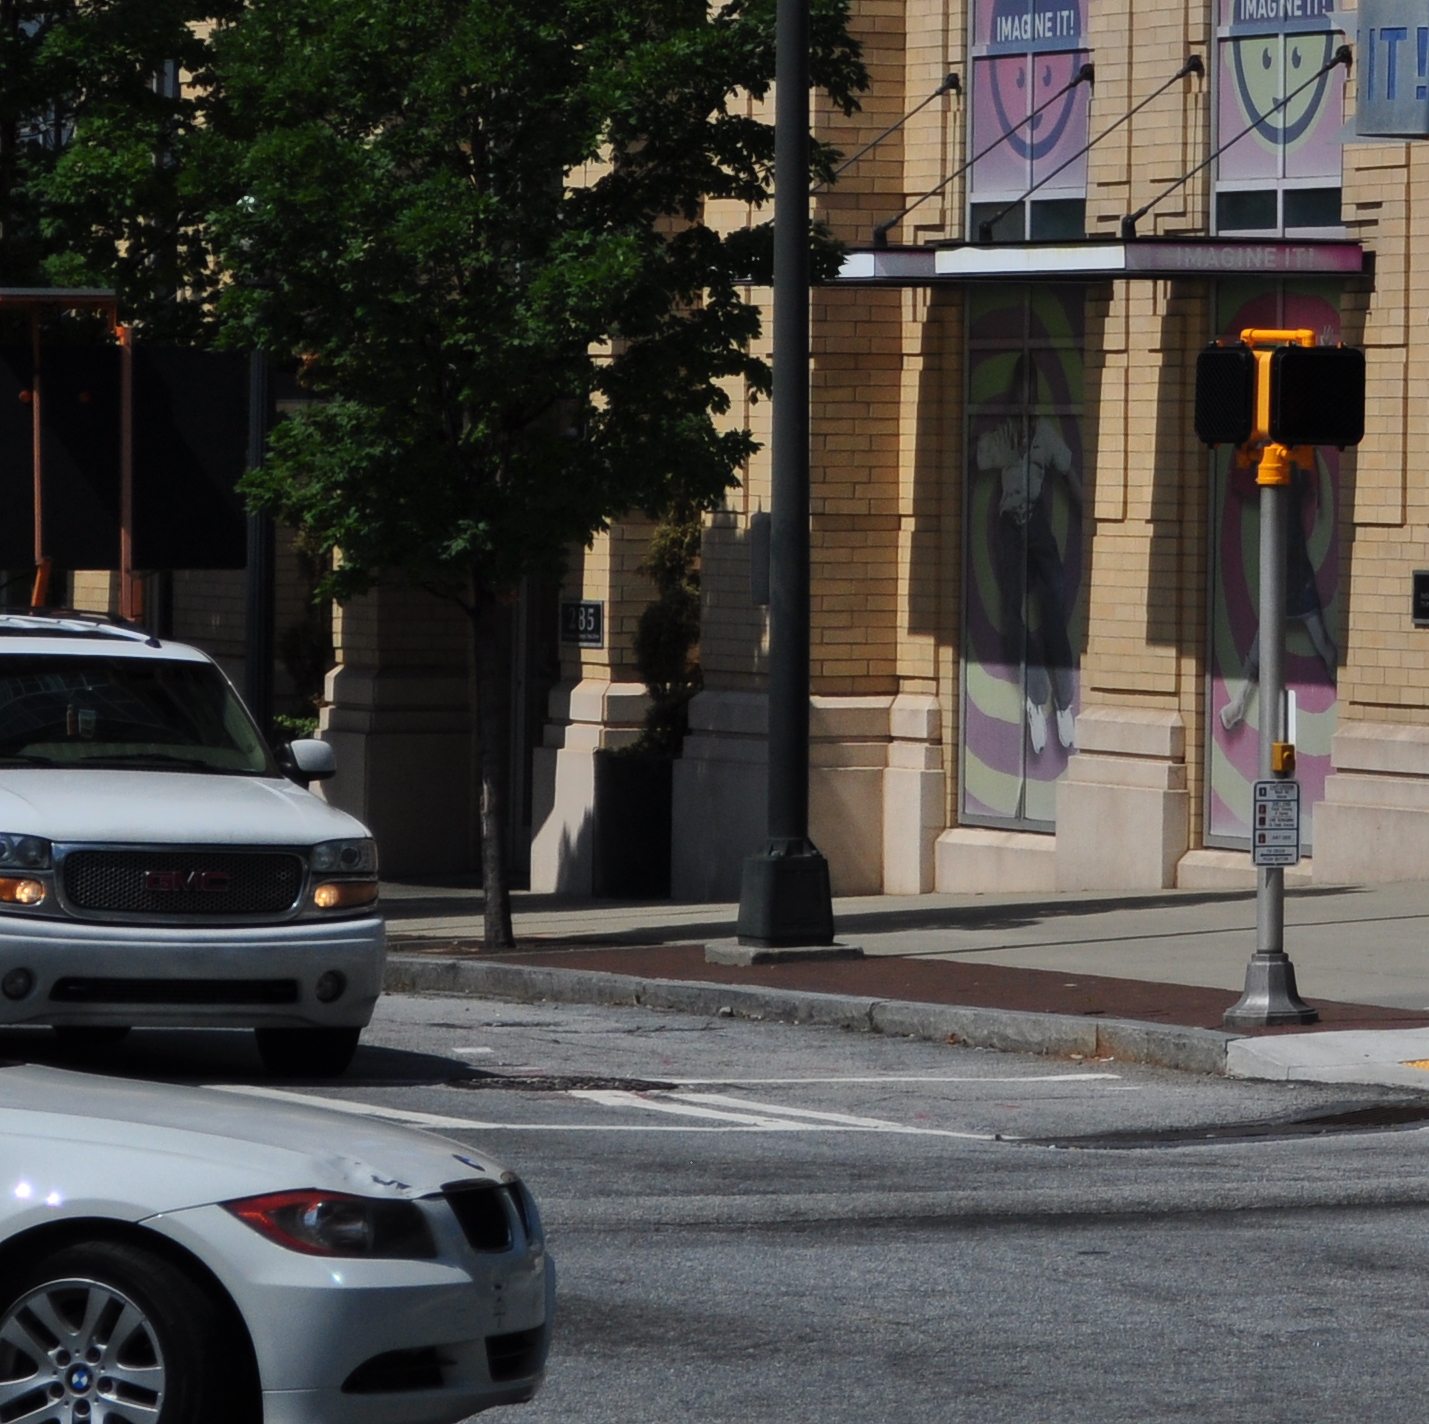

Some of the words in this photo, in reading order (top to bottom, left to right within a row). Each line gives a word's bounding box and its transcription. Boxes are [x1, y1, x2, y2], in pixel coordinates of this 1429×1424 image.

[1056, 10, 1075, 37] IT!
[1367, 26, 1429, 102] IT!
[1177, 246, 1278, 269] IMAGINE
[568, 606, 595, 631] 285
[144, 870, 229, 893] GMC
